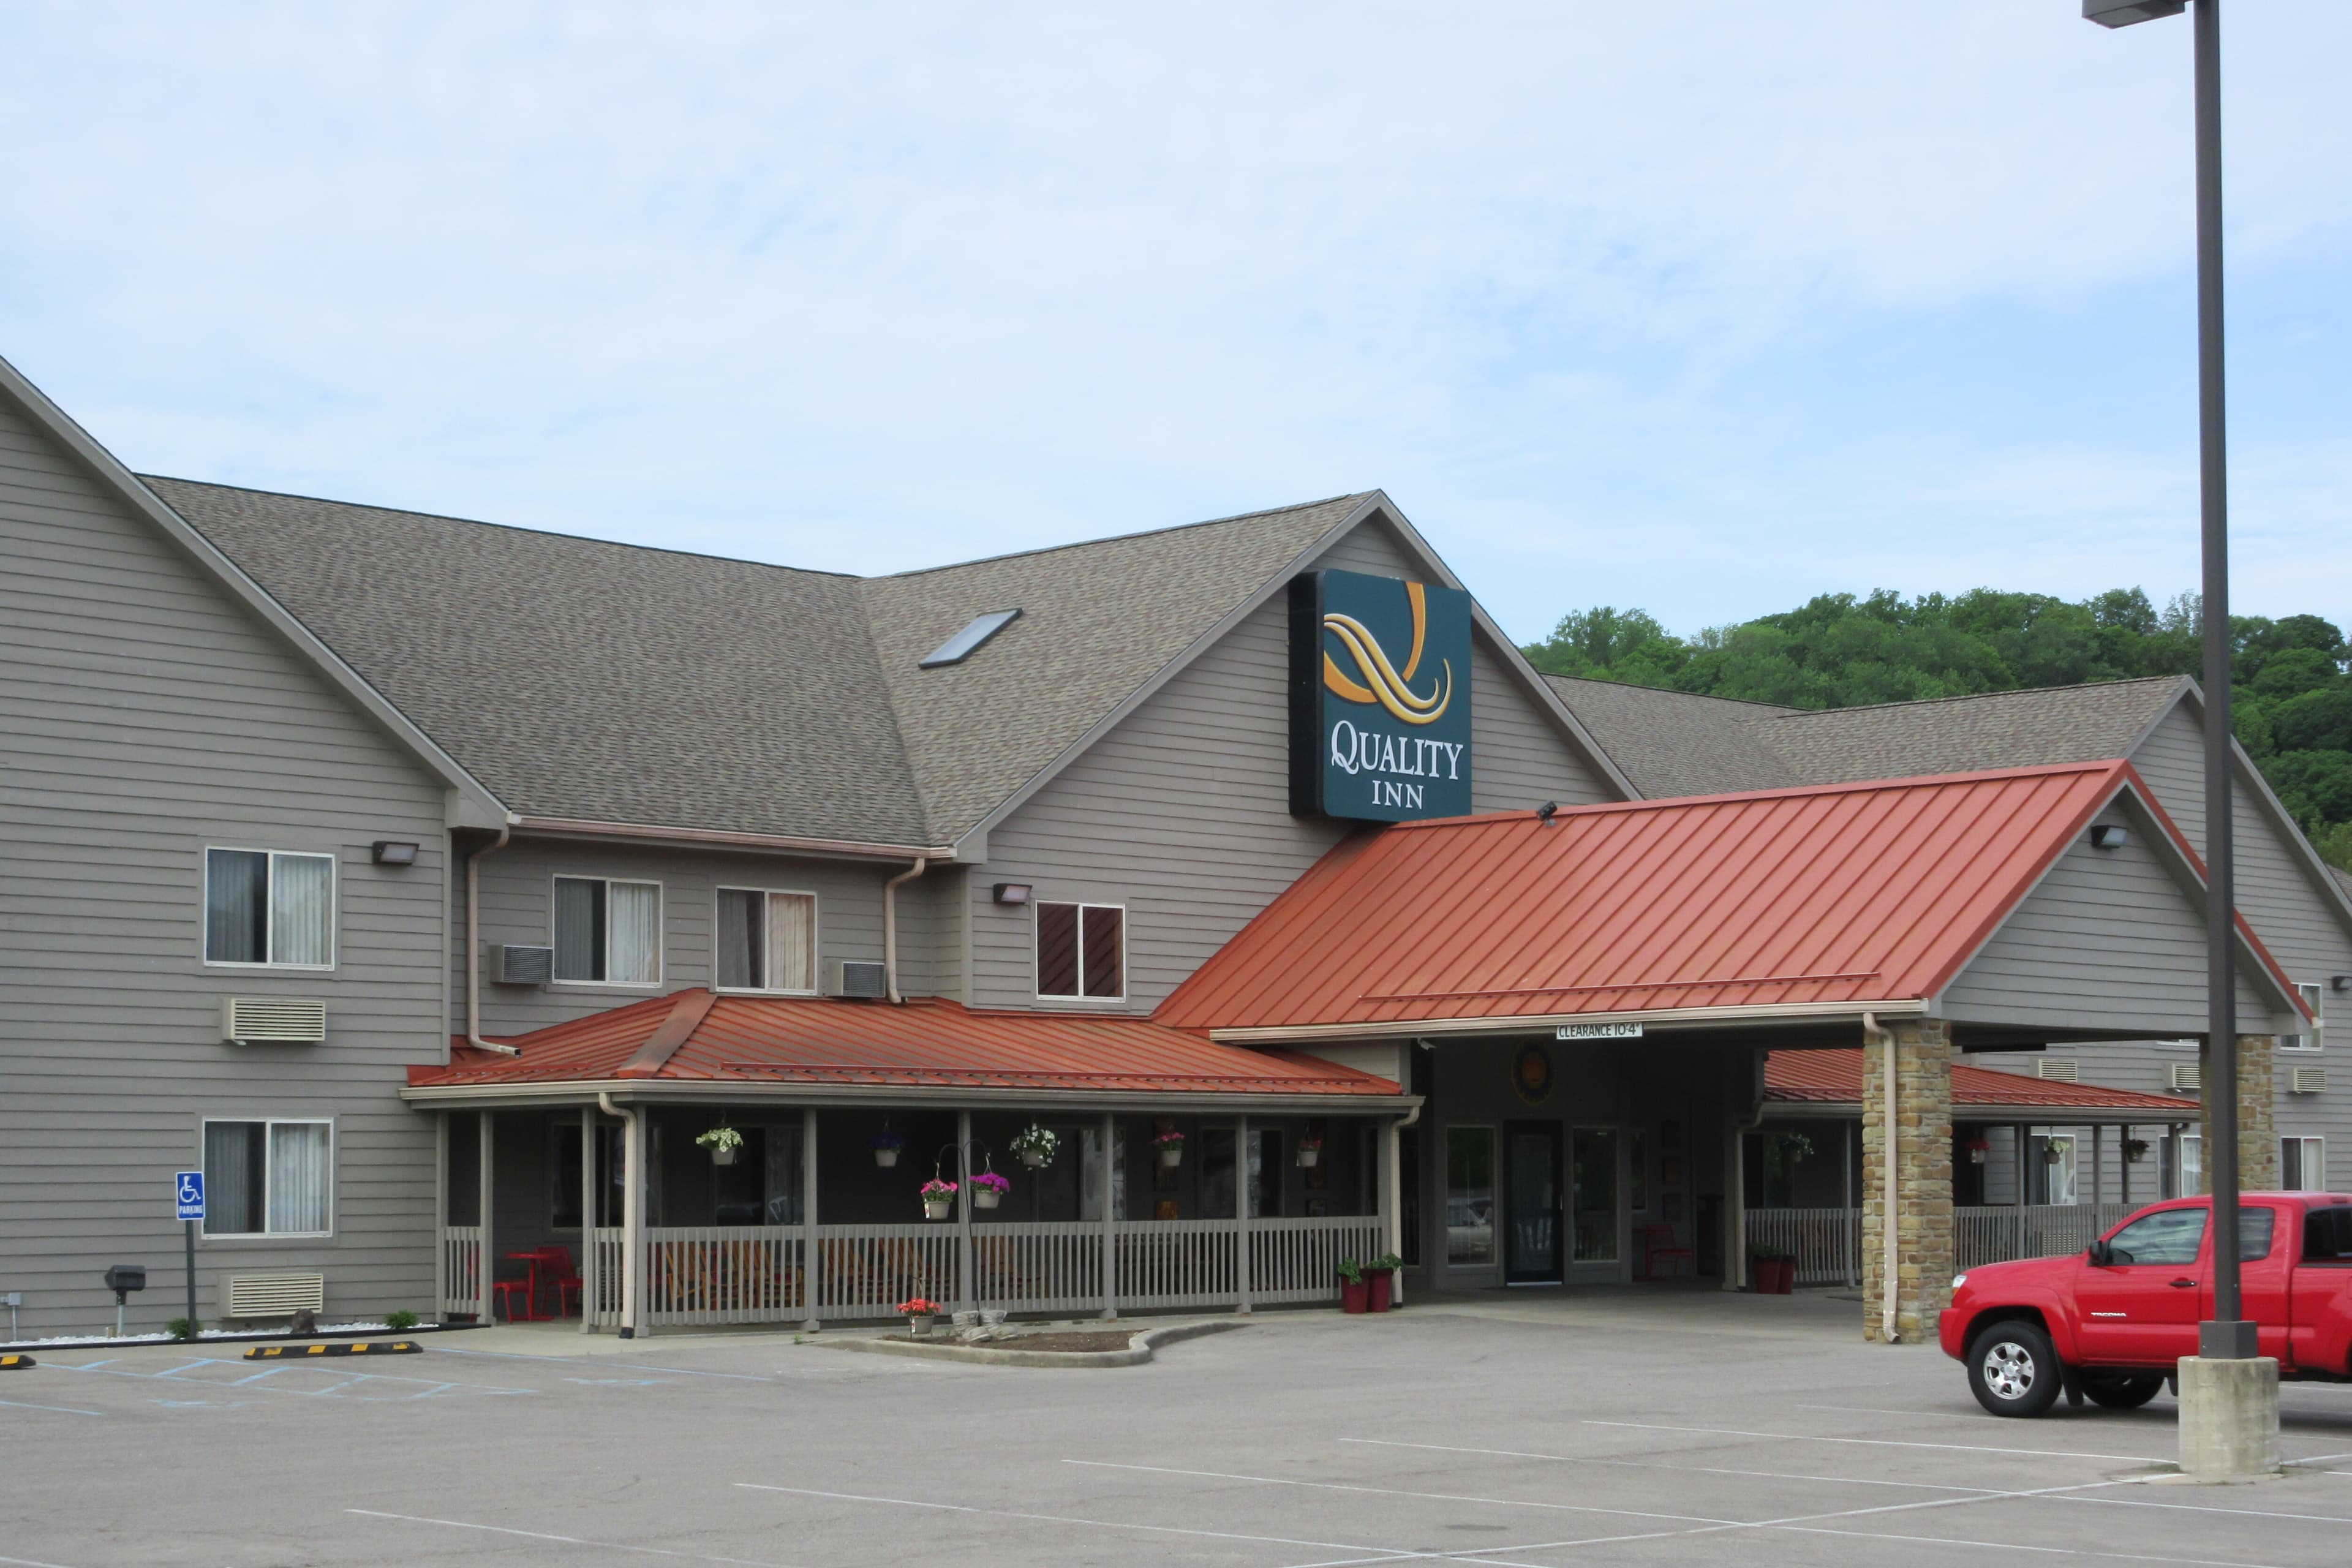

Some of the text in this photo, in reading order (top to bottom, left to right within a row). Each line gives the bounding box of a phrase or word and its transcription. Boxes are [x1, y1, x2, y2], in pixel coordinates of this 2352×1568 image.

[1332, 720, 1463, 780] QUALITY
[1372, 780, 1423, 809] INN
[1559, 1025, 1611, 1038] CLEARANCE
[179, 1205, 203, 1214] PARKING
